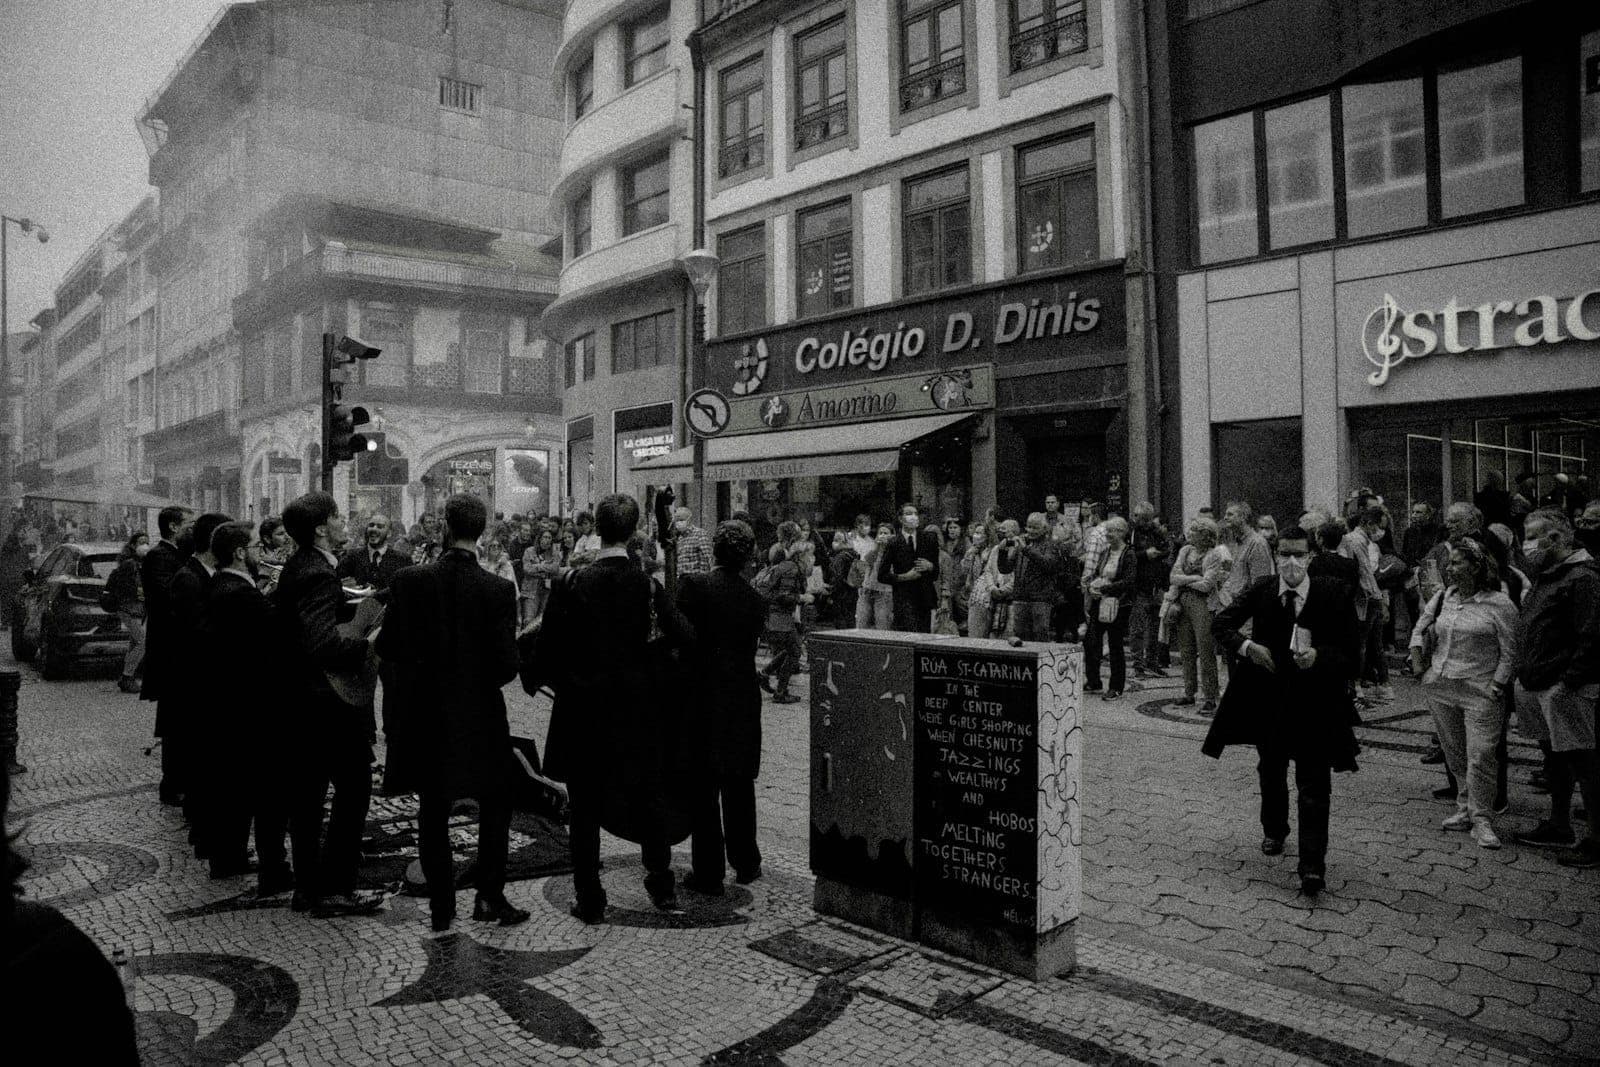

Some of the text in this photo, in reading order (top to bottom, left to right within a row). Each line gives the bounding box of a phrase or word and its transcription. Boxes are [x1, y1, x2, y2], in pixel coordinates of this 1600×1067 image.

[795, 291, 1101, 373] Colégio D. Dinis
[797, 387, 897, 422] Amorino
[449, 458, 492, 470] TEZENIS
[924, 697, 1003, 716] DEEP CENTER
[927, 728, 1024, 753] WHEN CHESNUTS
[947, 769, 1007, 792] WEALTHYS
[962, 792, 984, 806] AND
[988, 810, 1035, 833] HOBOS
[920, 838, 1007, 873] TOGETHERS
